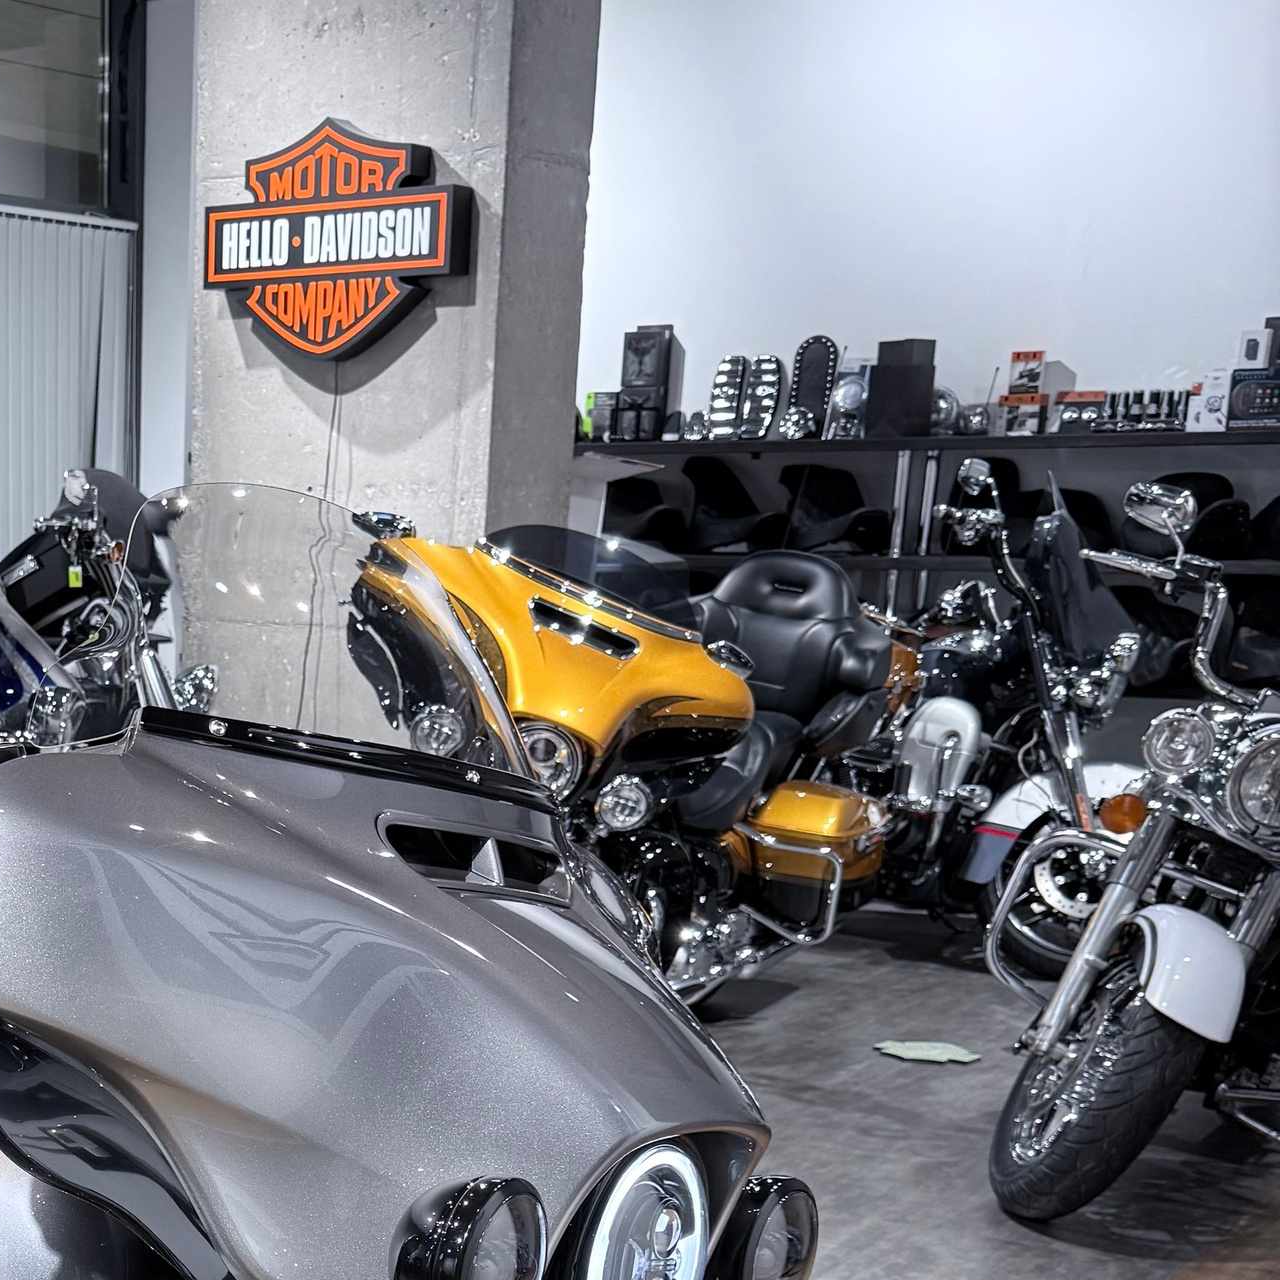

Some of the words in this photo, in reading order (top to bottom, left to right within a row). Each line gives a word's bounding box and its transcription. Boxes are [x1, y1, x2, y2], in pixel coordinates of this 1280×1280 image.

[269, 142, 384, 201] MOTOR
[221, 218, 289, 270] HELLO
[303, 206, 432, 264] DAVIDSON
[264, 276, 381, 343] COMPANY
